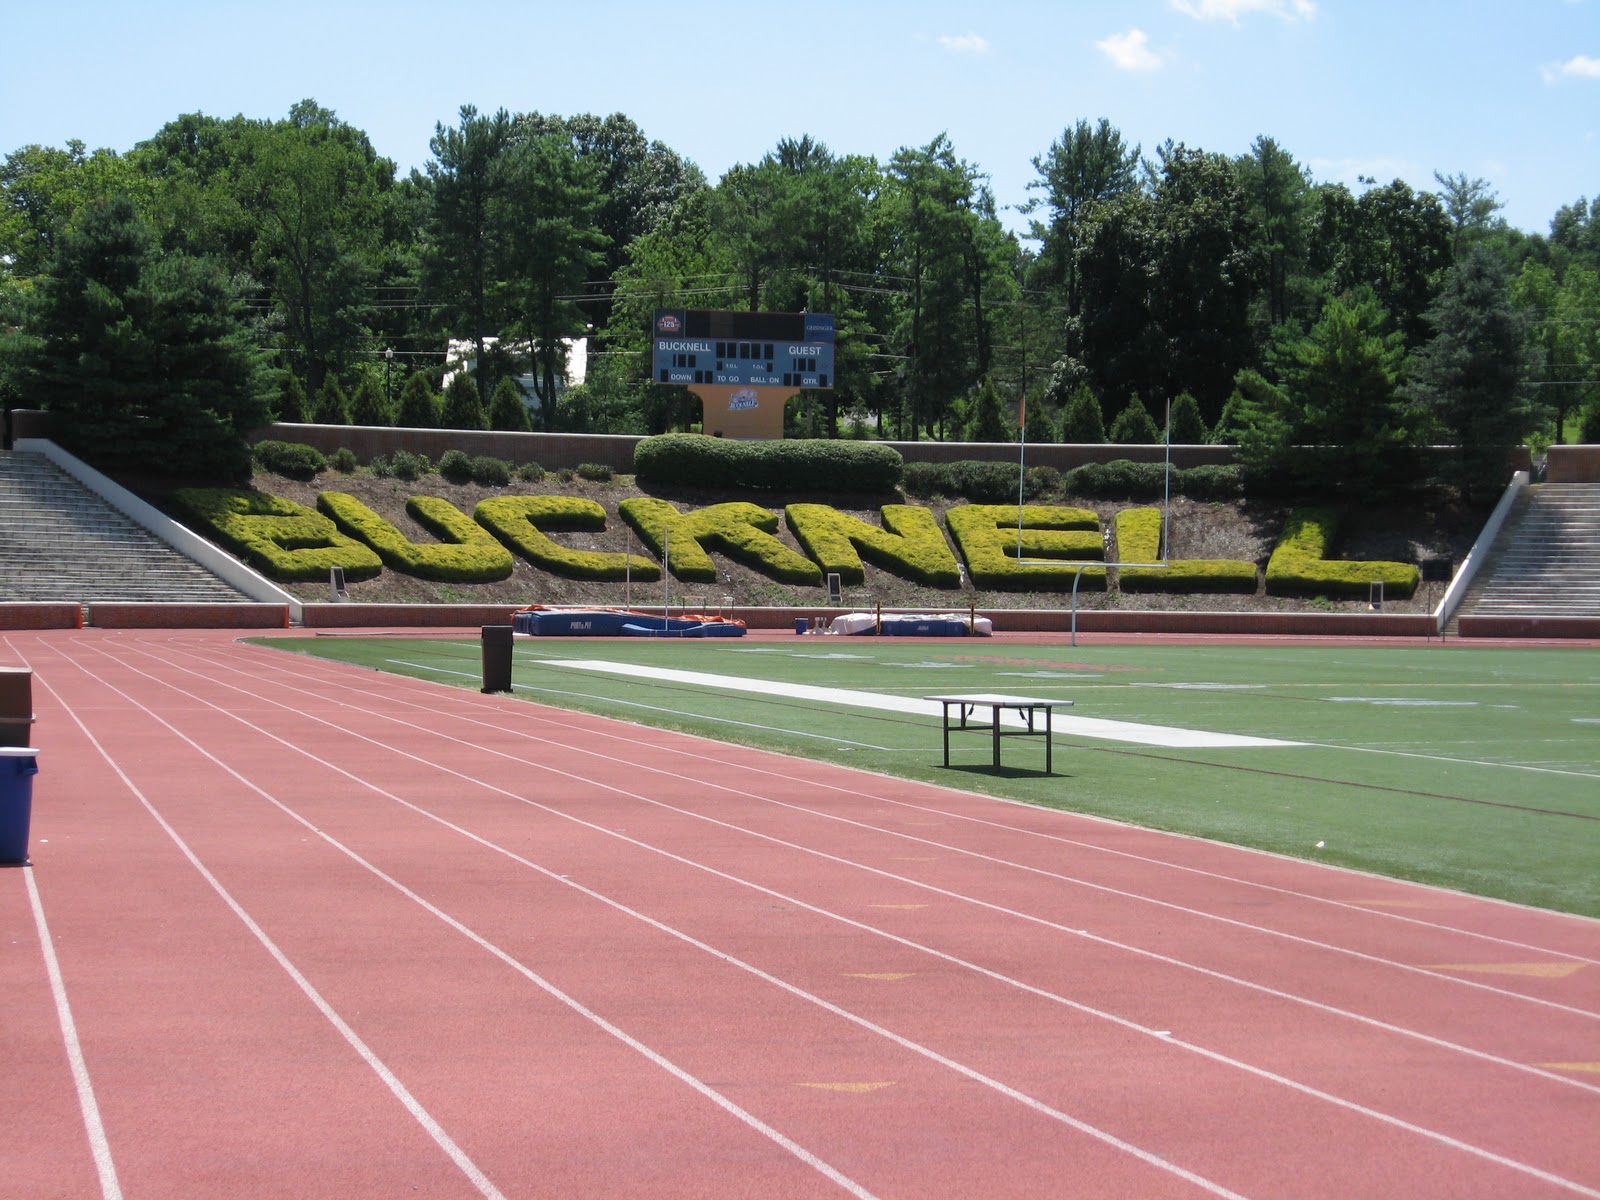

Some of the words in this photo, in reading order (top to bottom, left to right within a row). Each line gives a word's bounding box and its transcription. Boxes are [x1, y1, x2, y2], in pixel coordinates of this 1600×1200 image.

[659, 341, 711, 352] BUCKNELL
[788, 346, 822, 356] GUEST
[670, 373, 692, 381] DOWN
[173, 488, 1420, 600] BUCKNELL
